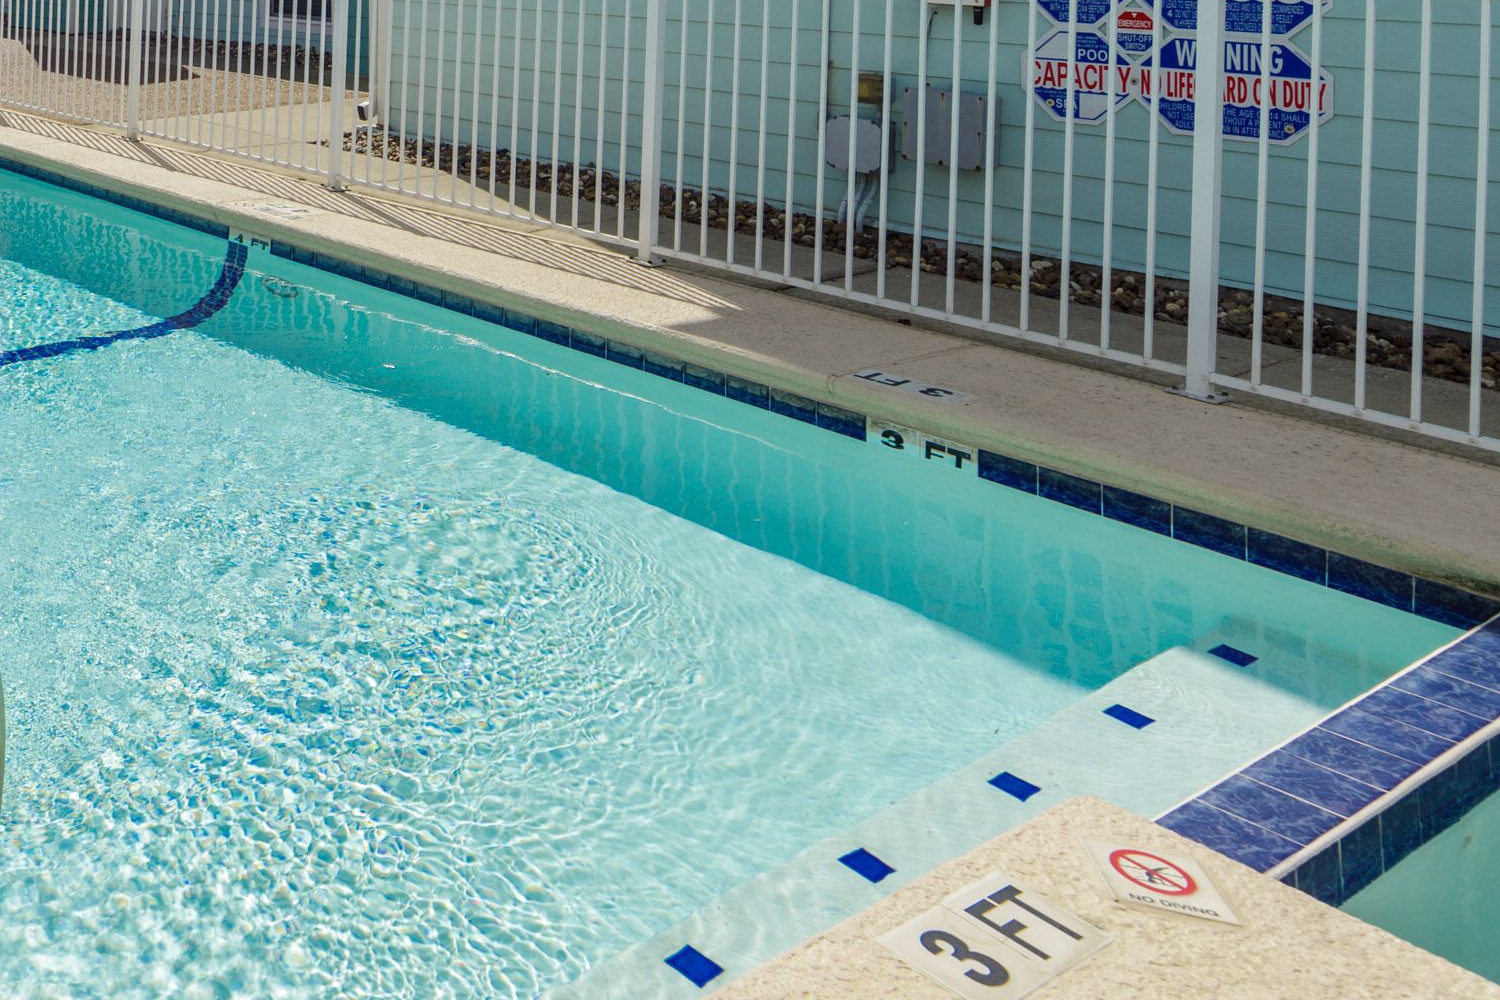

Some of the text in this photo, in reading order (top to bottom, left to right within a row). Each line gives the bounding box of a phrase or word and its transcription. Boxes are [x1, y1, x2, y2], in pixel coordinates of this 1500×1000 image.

[1117, 19, 1152, 28] EMERGENCY
[1118, 33, 1152, 42] SHUT-OFF
[1125, 42, 1146, 50] SWITCH
[1077, 49, 1108, 61] POO
[1175, 40, 1284, 74] WNING
[1167, 71, 1248, 104] LIFERD
[1159, 102, 1192, 112] HILDREN
[1239, 109, 1255, 118] AGE
[1281, 113, 1308, 124] SHALL
[251, 237, 269, 250] FT
[853, 372, 954, 398] 3 FT
[881, 429, 972, 470] 3 FT
[1128, 892, 1222, 919] NO DIVING
[919, 884, 1086, 988] 3 FT
